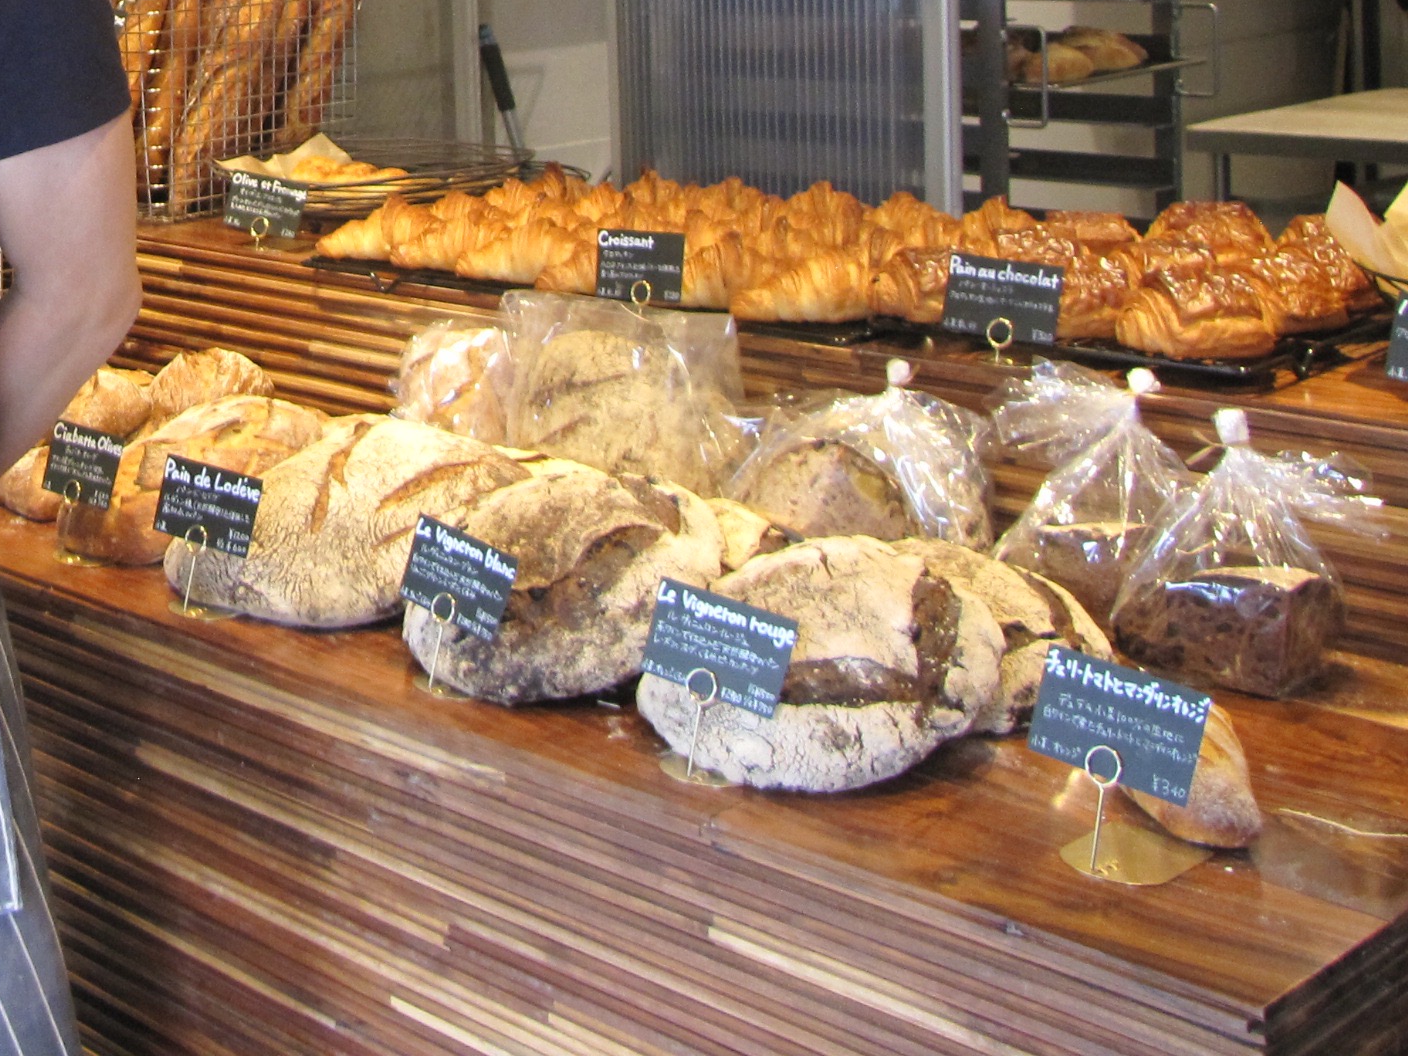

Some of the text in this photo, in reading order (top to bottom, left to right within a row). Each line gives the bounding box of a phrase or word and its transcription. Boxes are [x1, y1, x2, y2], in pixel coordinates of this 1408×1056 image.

[232, 172, 258, 188] Olive
[261, 180, 272, 191] et
[598, 230, 655, 249] Croissant
[949, 255, 1060, 289] Pain au chocolat
[53, 422, 96, 450] Ciabatta
[97, 435, 123, 456] Olives
[165, 457, 191, 484] Pain
[194, 466, 211, 488] de
[415, 517, 516, 580] Le Vigneron blanc
[657, 580, 797, 649] Le Vigneron rouge
[1153, 772, 1186, 799] ¥340
